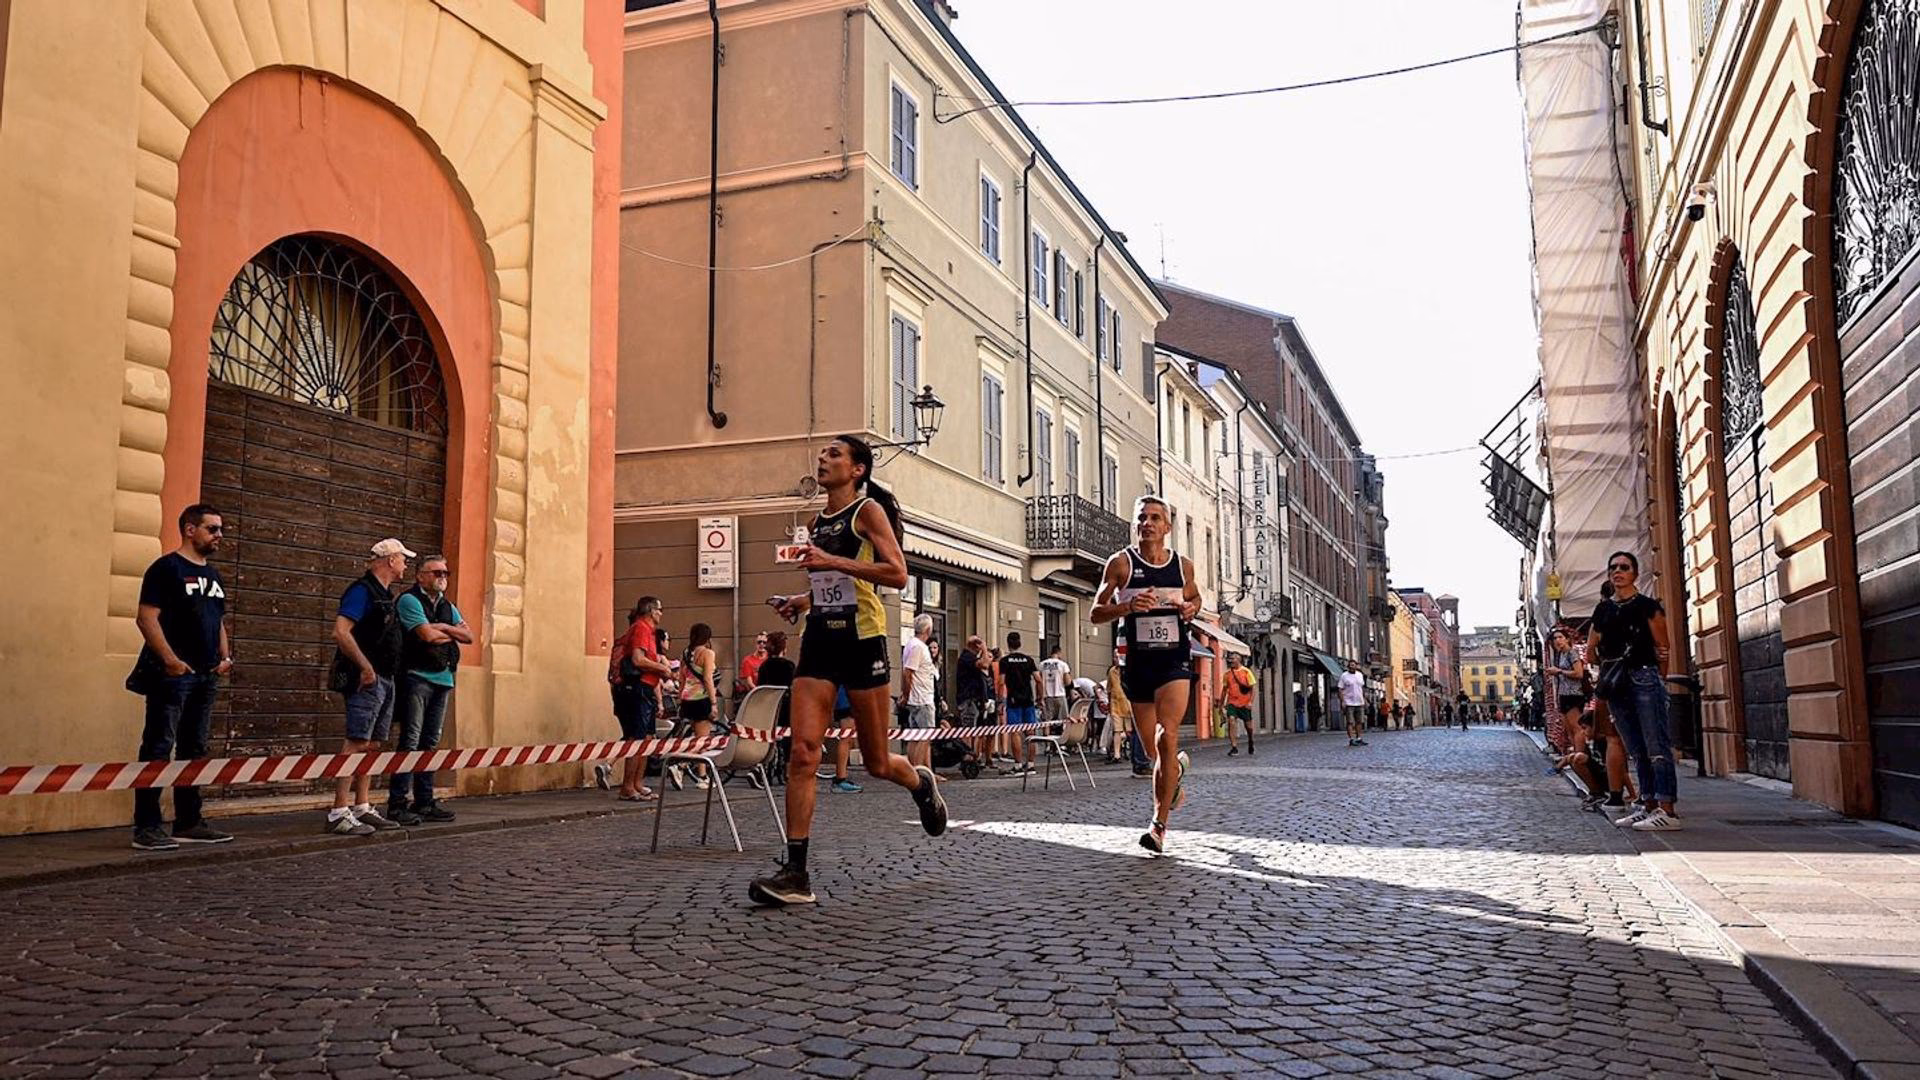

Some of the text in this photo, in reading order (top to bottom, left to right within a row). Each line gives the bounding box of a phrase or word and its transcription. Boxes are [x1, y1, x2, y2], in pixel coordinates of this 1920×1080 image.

[1254, 469, 1268, 600] FERRARINI
[821, 584, 843, 604] 156
[1149, 626, 1169, 640] 189
